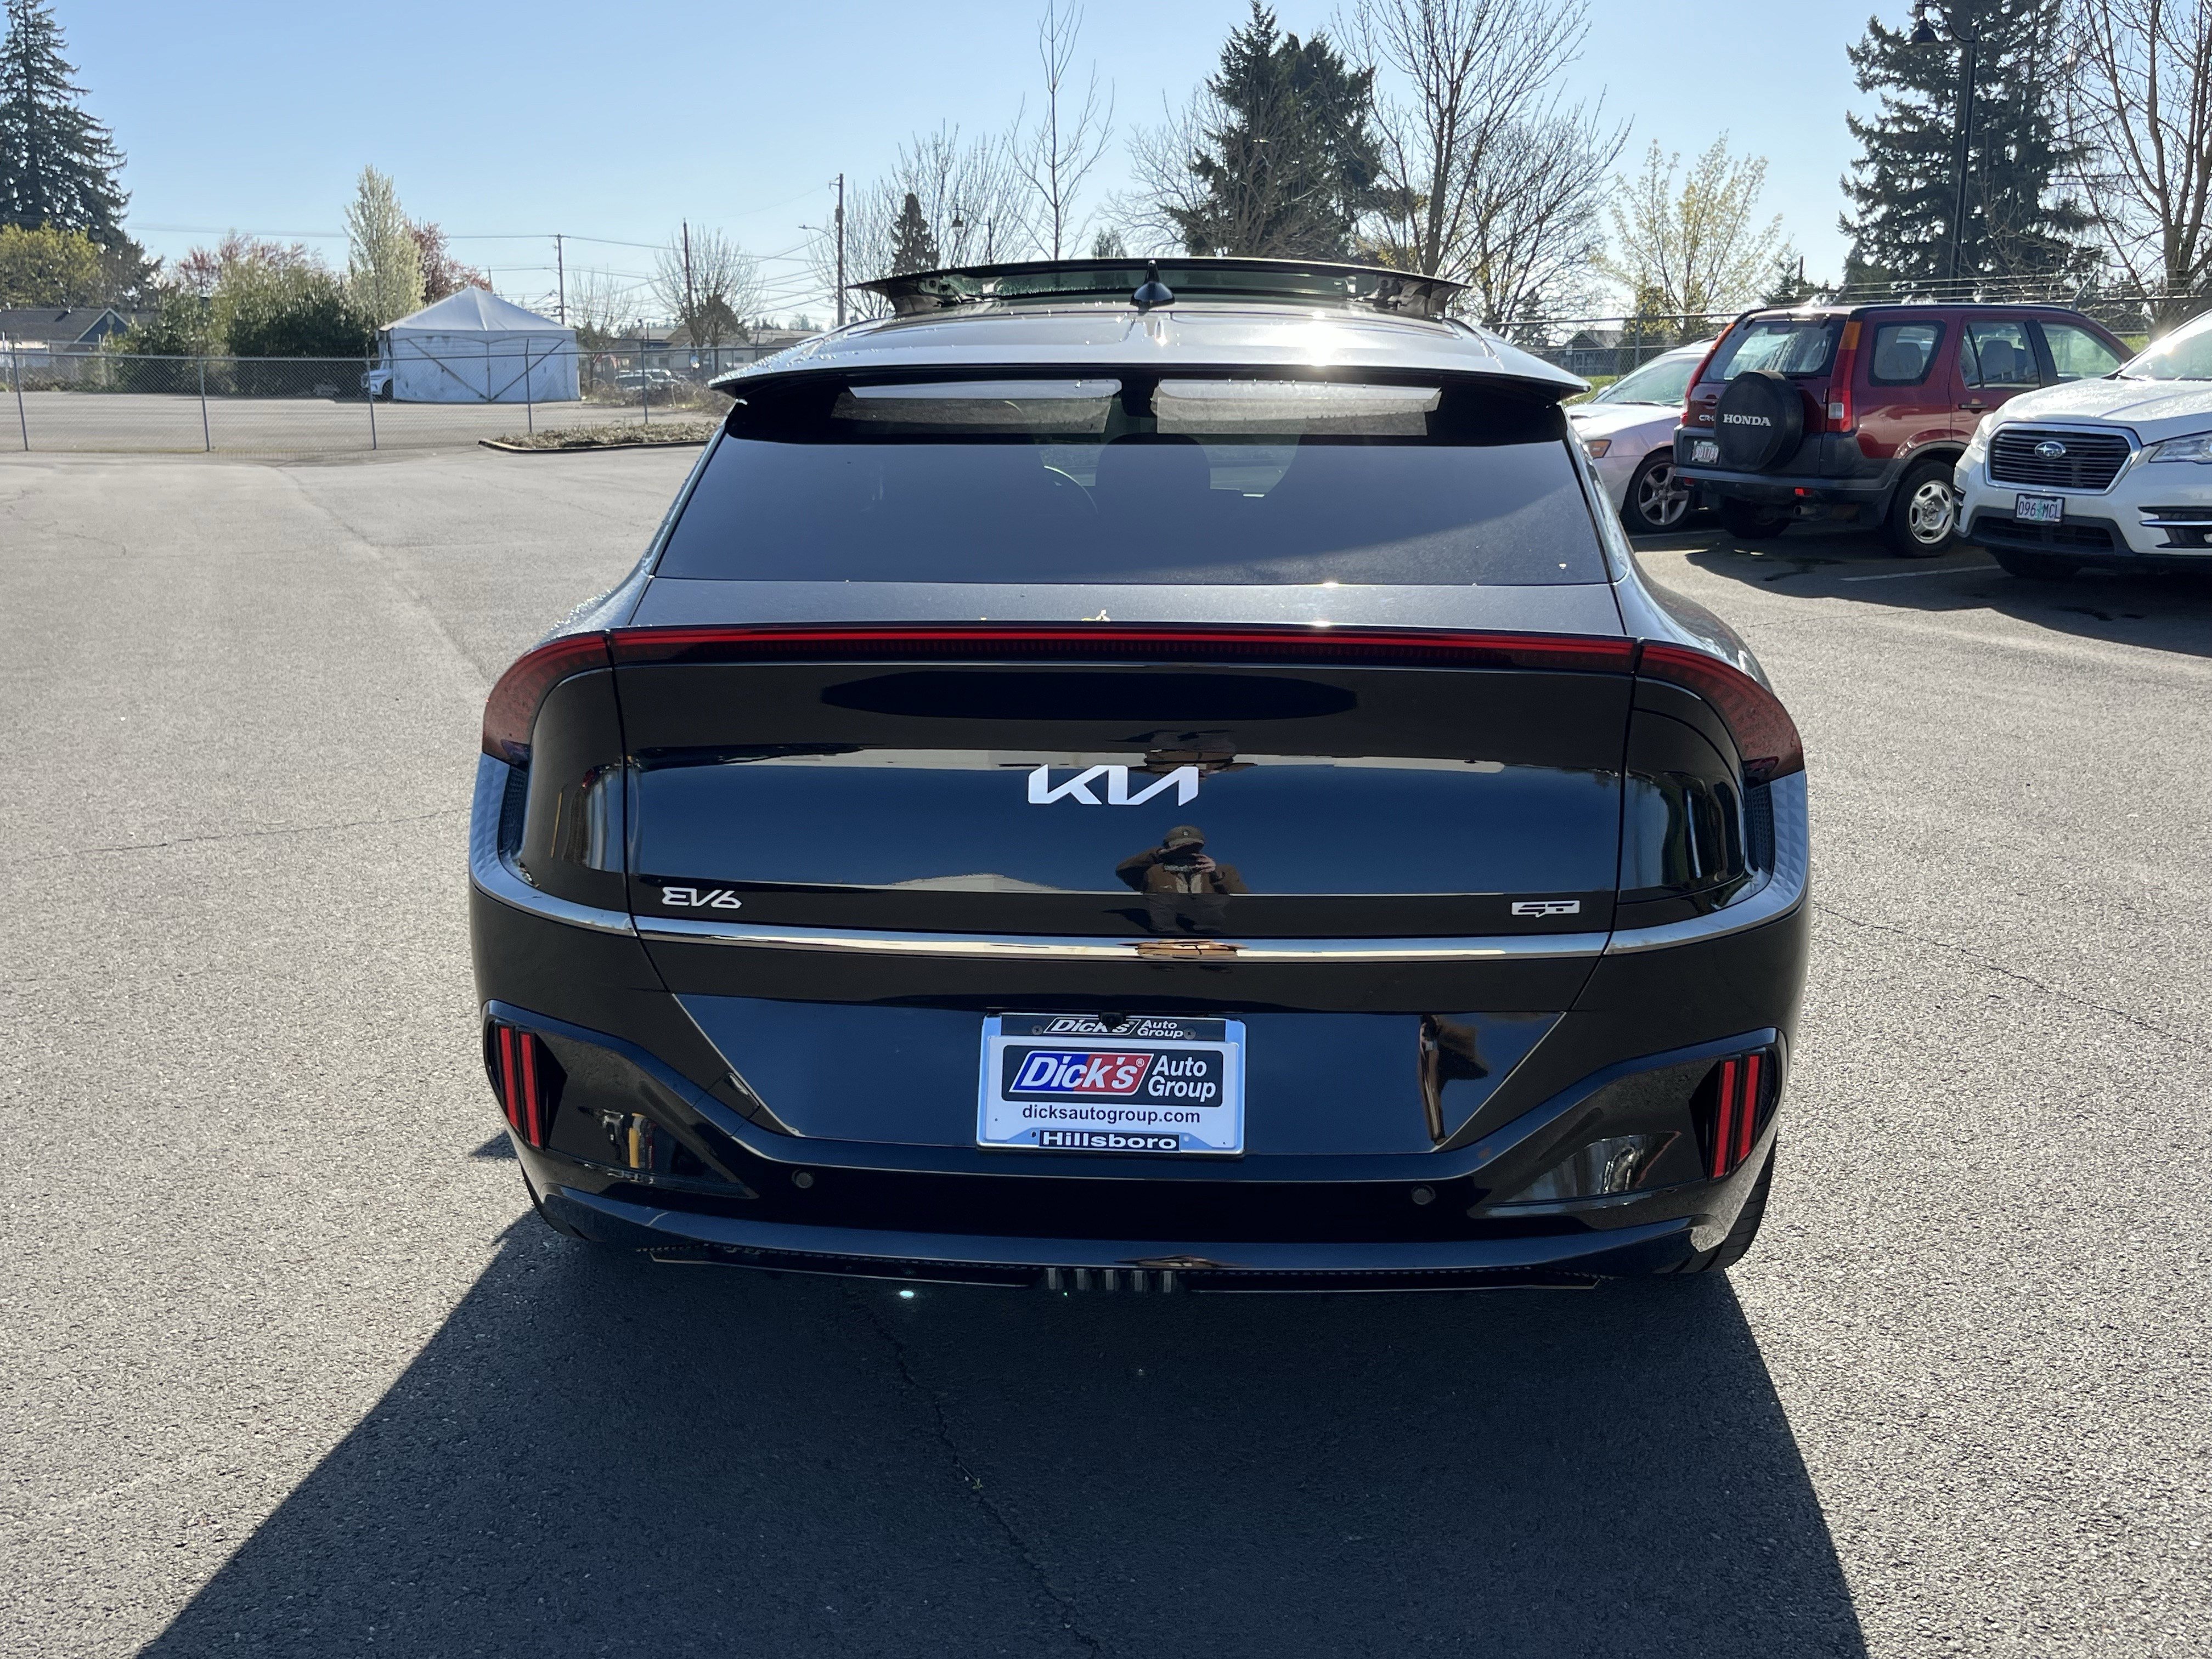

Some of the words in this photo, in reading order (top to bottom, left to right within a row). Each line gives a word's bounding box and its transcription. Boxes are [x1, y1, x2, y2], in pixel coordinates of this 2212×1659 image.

[1723, 414, 1771, 427] HONDA
[2018, 501, 2036, 517] 096
[2042, 503, 2060, 518] MCL
[662, 887, 742, 909] EV6
[1051, 1019, 1130, 1033] Dicks
[1141, 1019, 1177, 1029] Auto
[1137, 1028, 1184, 1039] Group
[1152, 1055, 1207, 1077] Auto
[1148, 1075, 1217, 1103] Group
[1022, 1104, 1200, 1125] dicksautogroup.com
[1043, 1131, 1177, 1150] Hillsboro
